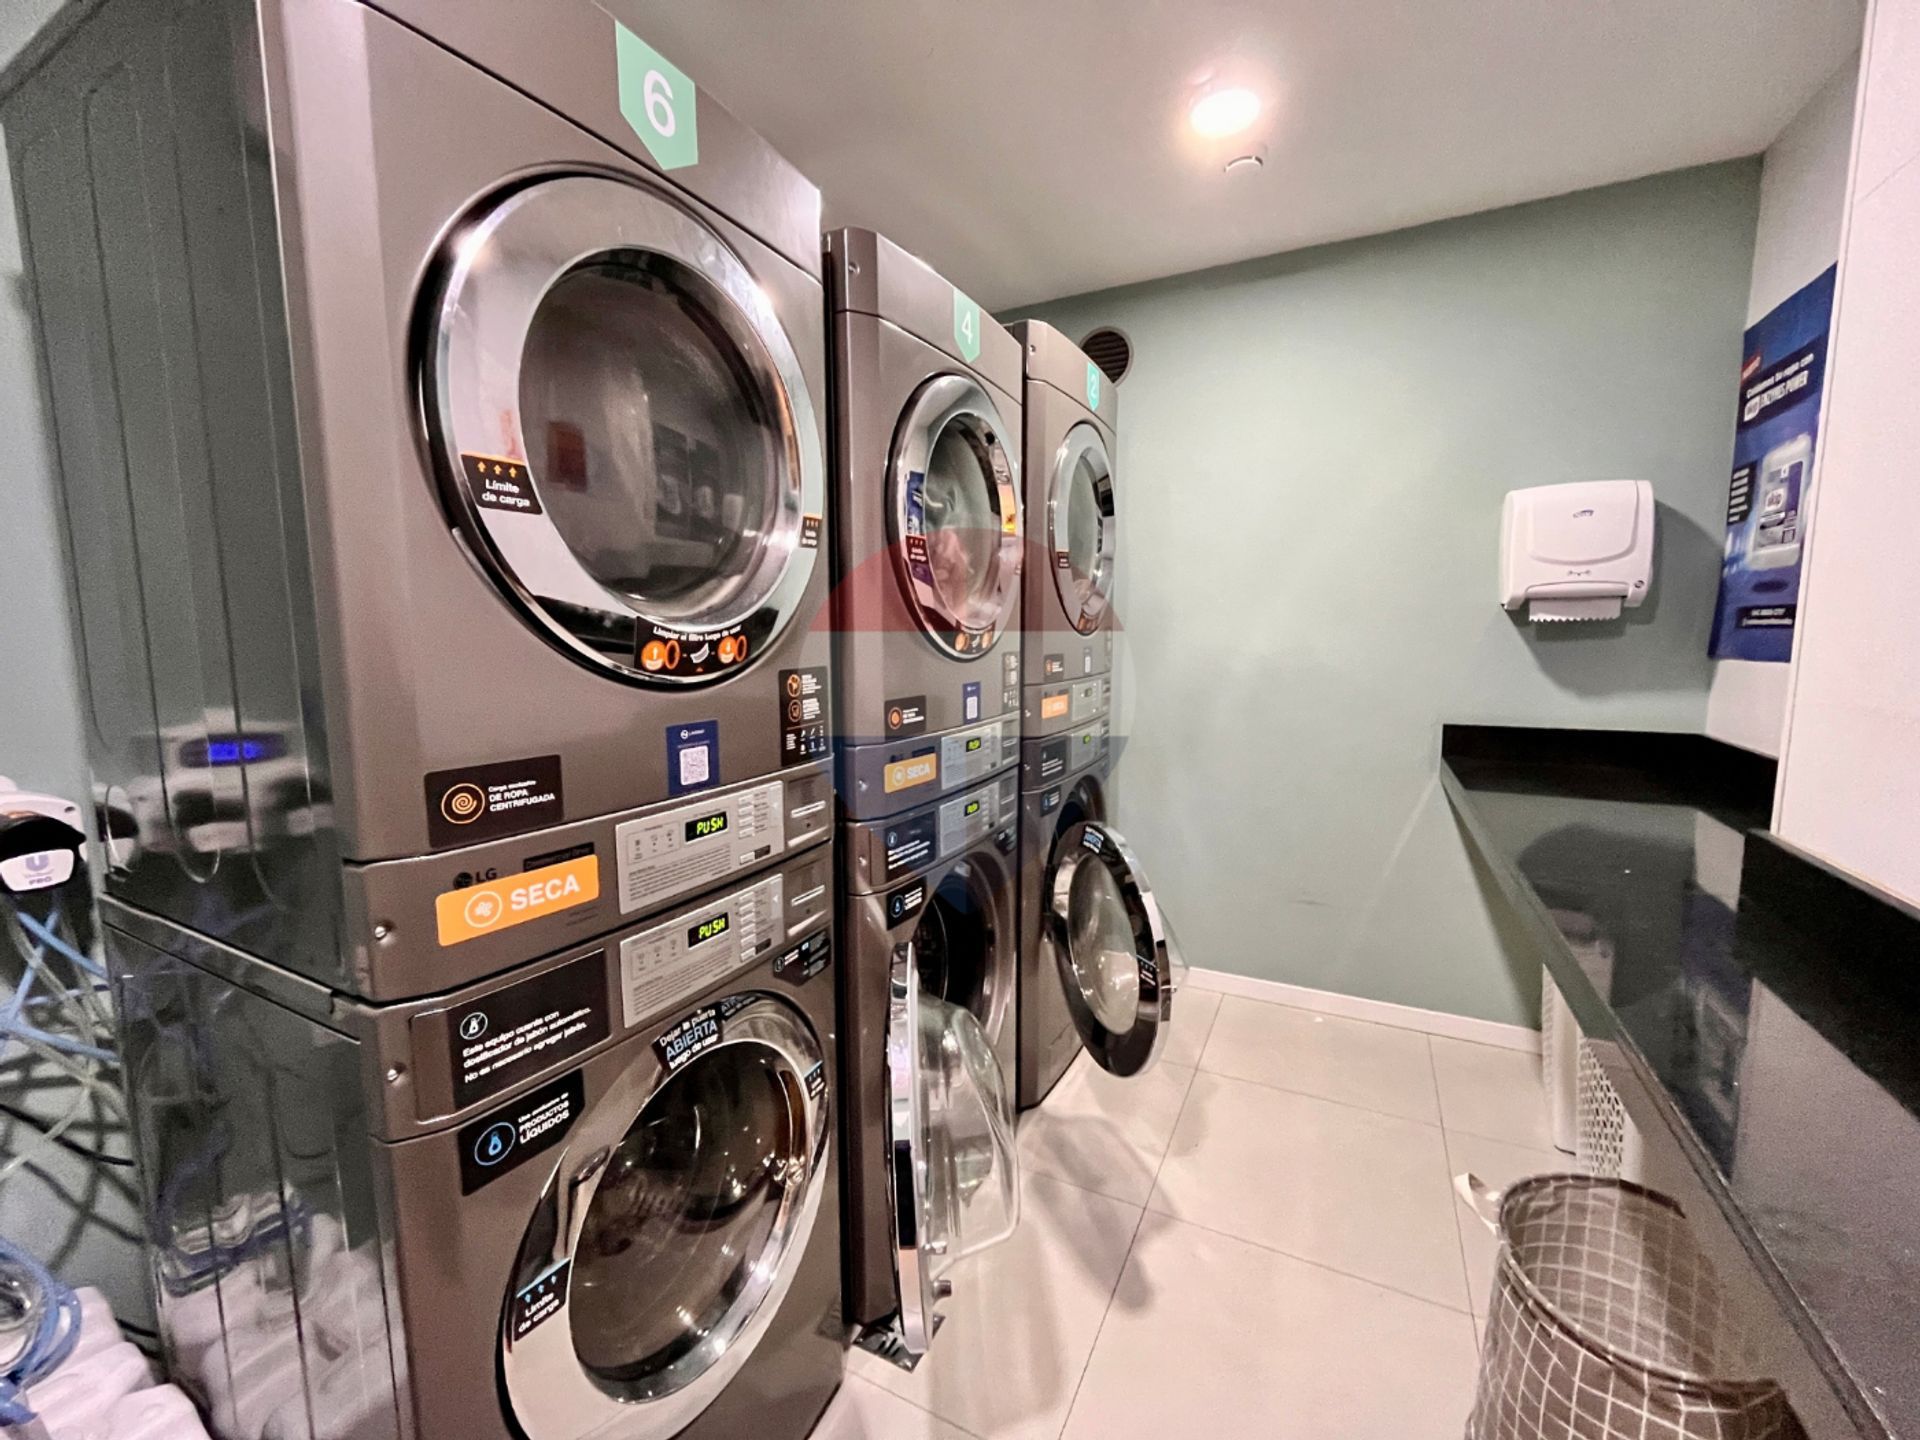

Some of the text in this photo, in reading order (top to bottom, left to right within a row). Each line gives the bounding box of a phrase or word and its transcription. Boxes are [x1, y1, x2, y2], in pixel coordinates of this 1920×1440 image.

[643, 69, 676, 138] 6
[960, 310, 974, 345] 4
[1089, 373, 1098, 397] 2
[481, 491, 531, 508] de carga
[485, 478, 520, 493] Límite
[907, 763, 930, 779] SECA
[489, 788, 529, 803] DE ROPA
[489, 792, 556, 812] CENTRIFUGADA
[696, 816, 724, 835] PUSH
[28, 875, 53, 886] PRO
[475, 867, 498, 883] LG
[510, 873, 581, 911] SECA
[698, 917, 726, 939] PUSH
[462, 1011, 560, 1058] Este equipo cuenta con
[659, 1027, 682, 1047] Dejar
[691, 1008, 716, 1028] puerta
[666, 1020, 718, 1060] ABIERTA
[463, 1041, 512, 1069] dosificador
[513, 1036, 525, 1046] de
[525, 1026, 549, 1043] jabón
[668, 1033, 719, 1070] luego de usar
[464, 1071, 479, 1083] No
[479, 1066, 491, 1076] es
[491, 1046, 532, 1070] necesario
[519, 1100, 569, 1133] PRODUCTOS
[518, 1298, 560, 1333] de carga
